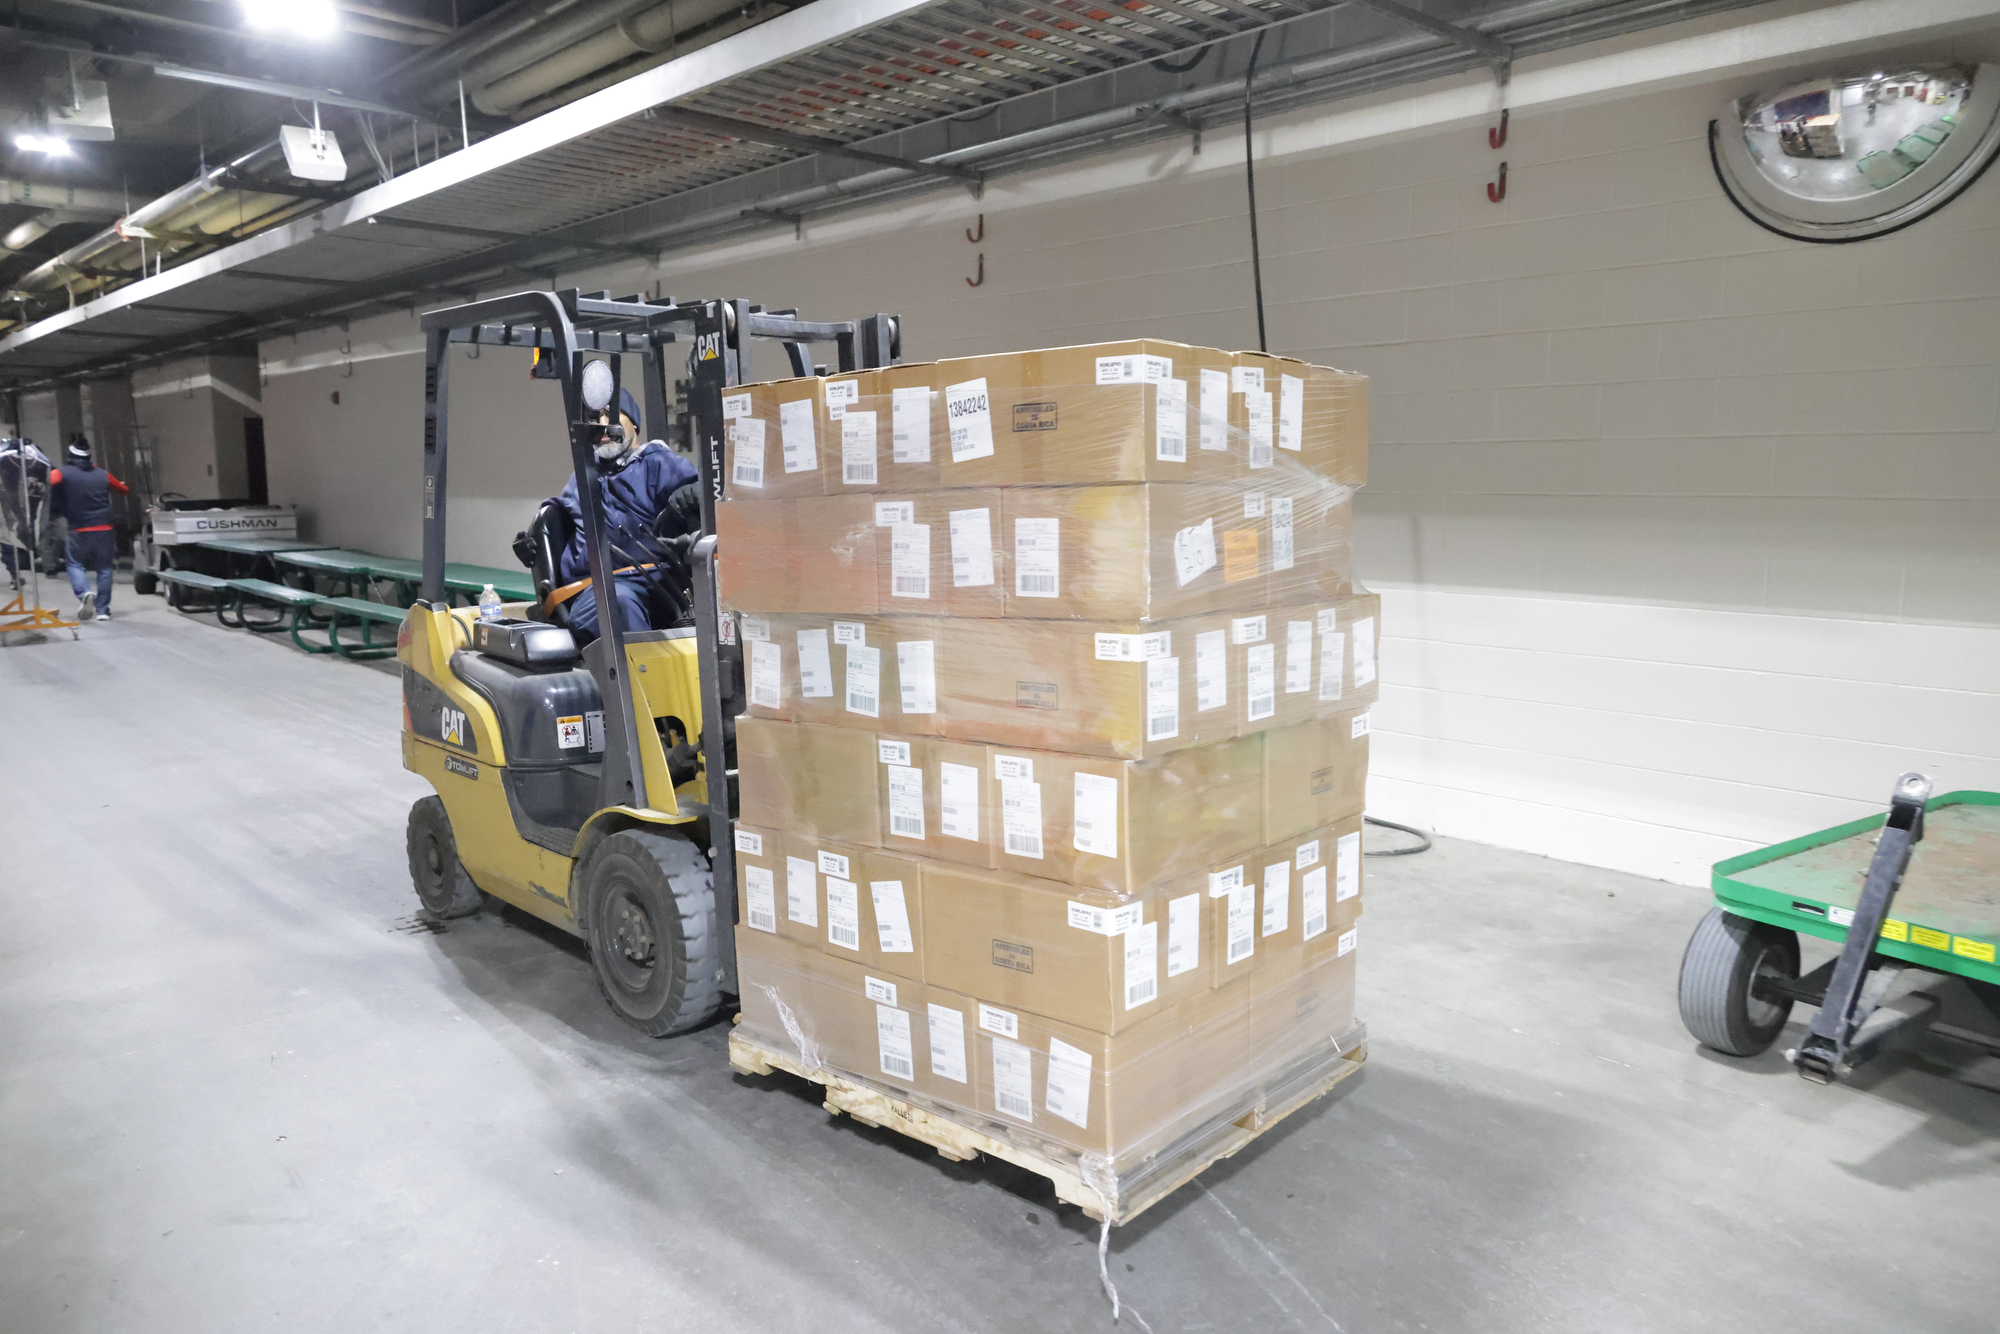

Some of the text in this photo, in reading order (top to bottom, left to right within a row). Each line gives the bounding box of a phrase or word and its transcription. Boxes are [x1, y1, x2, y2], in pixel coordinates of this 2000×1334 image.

[698, 332, 720, 362] CAT
[948, 394, 987, 418] 13842242
[1039, 420, 1055, 428] RICA
[196, 519, 278, 530] CUSHMAN
[442, 706, 466, 746] CAT
[452, 761, 478, 776] TOWLIFT
[995, 956, 1030, 970] COSTA RICA
